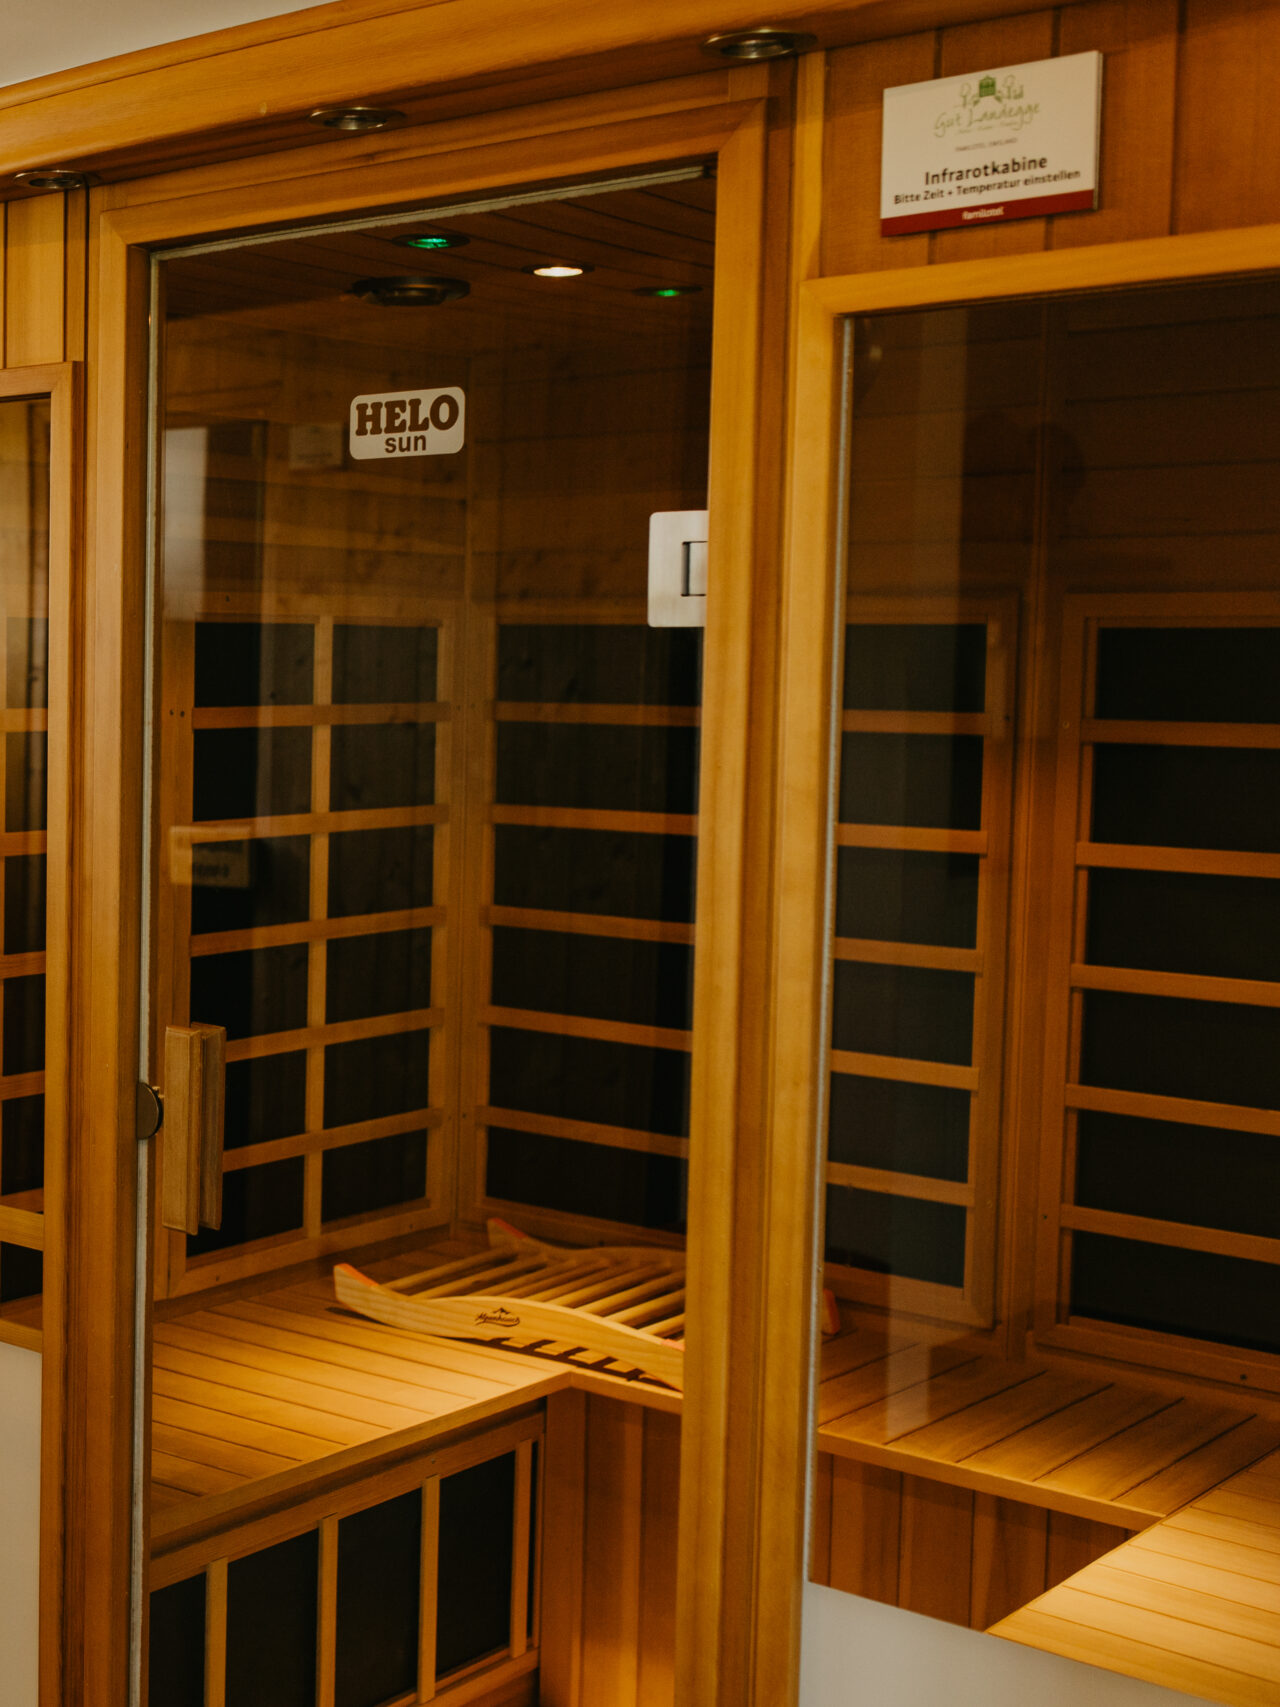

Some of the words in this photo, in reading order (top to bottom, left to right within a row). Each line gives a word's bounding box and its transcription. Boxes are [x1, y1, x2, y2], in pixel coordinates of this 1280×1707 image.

[894, 193, 921, 205] Bitte
[924, 188, 944, 201] Zeit
[957, 180, 1021, 196] Temperatur
[1024, 169, 1081, 187] einstellen
[925, 157, 1048, 186] Infrarotkabine
[355, 394, 459, 436] HELO
[384, 434, 427, 453] sun
